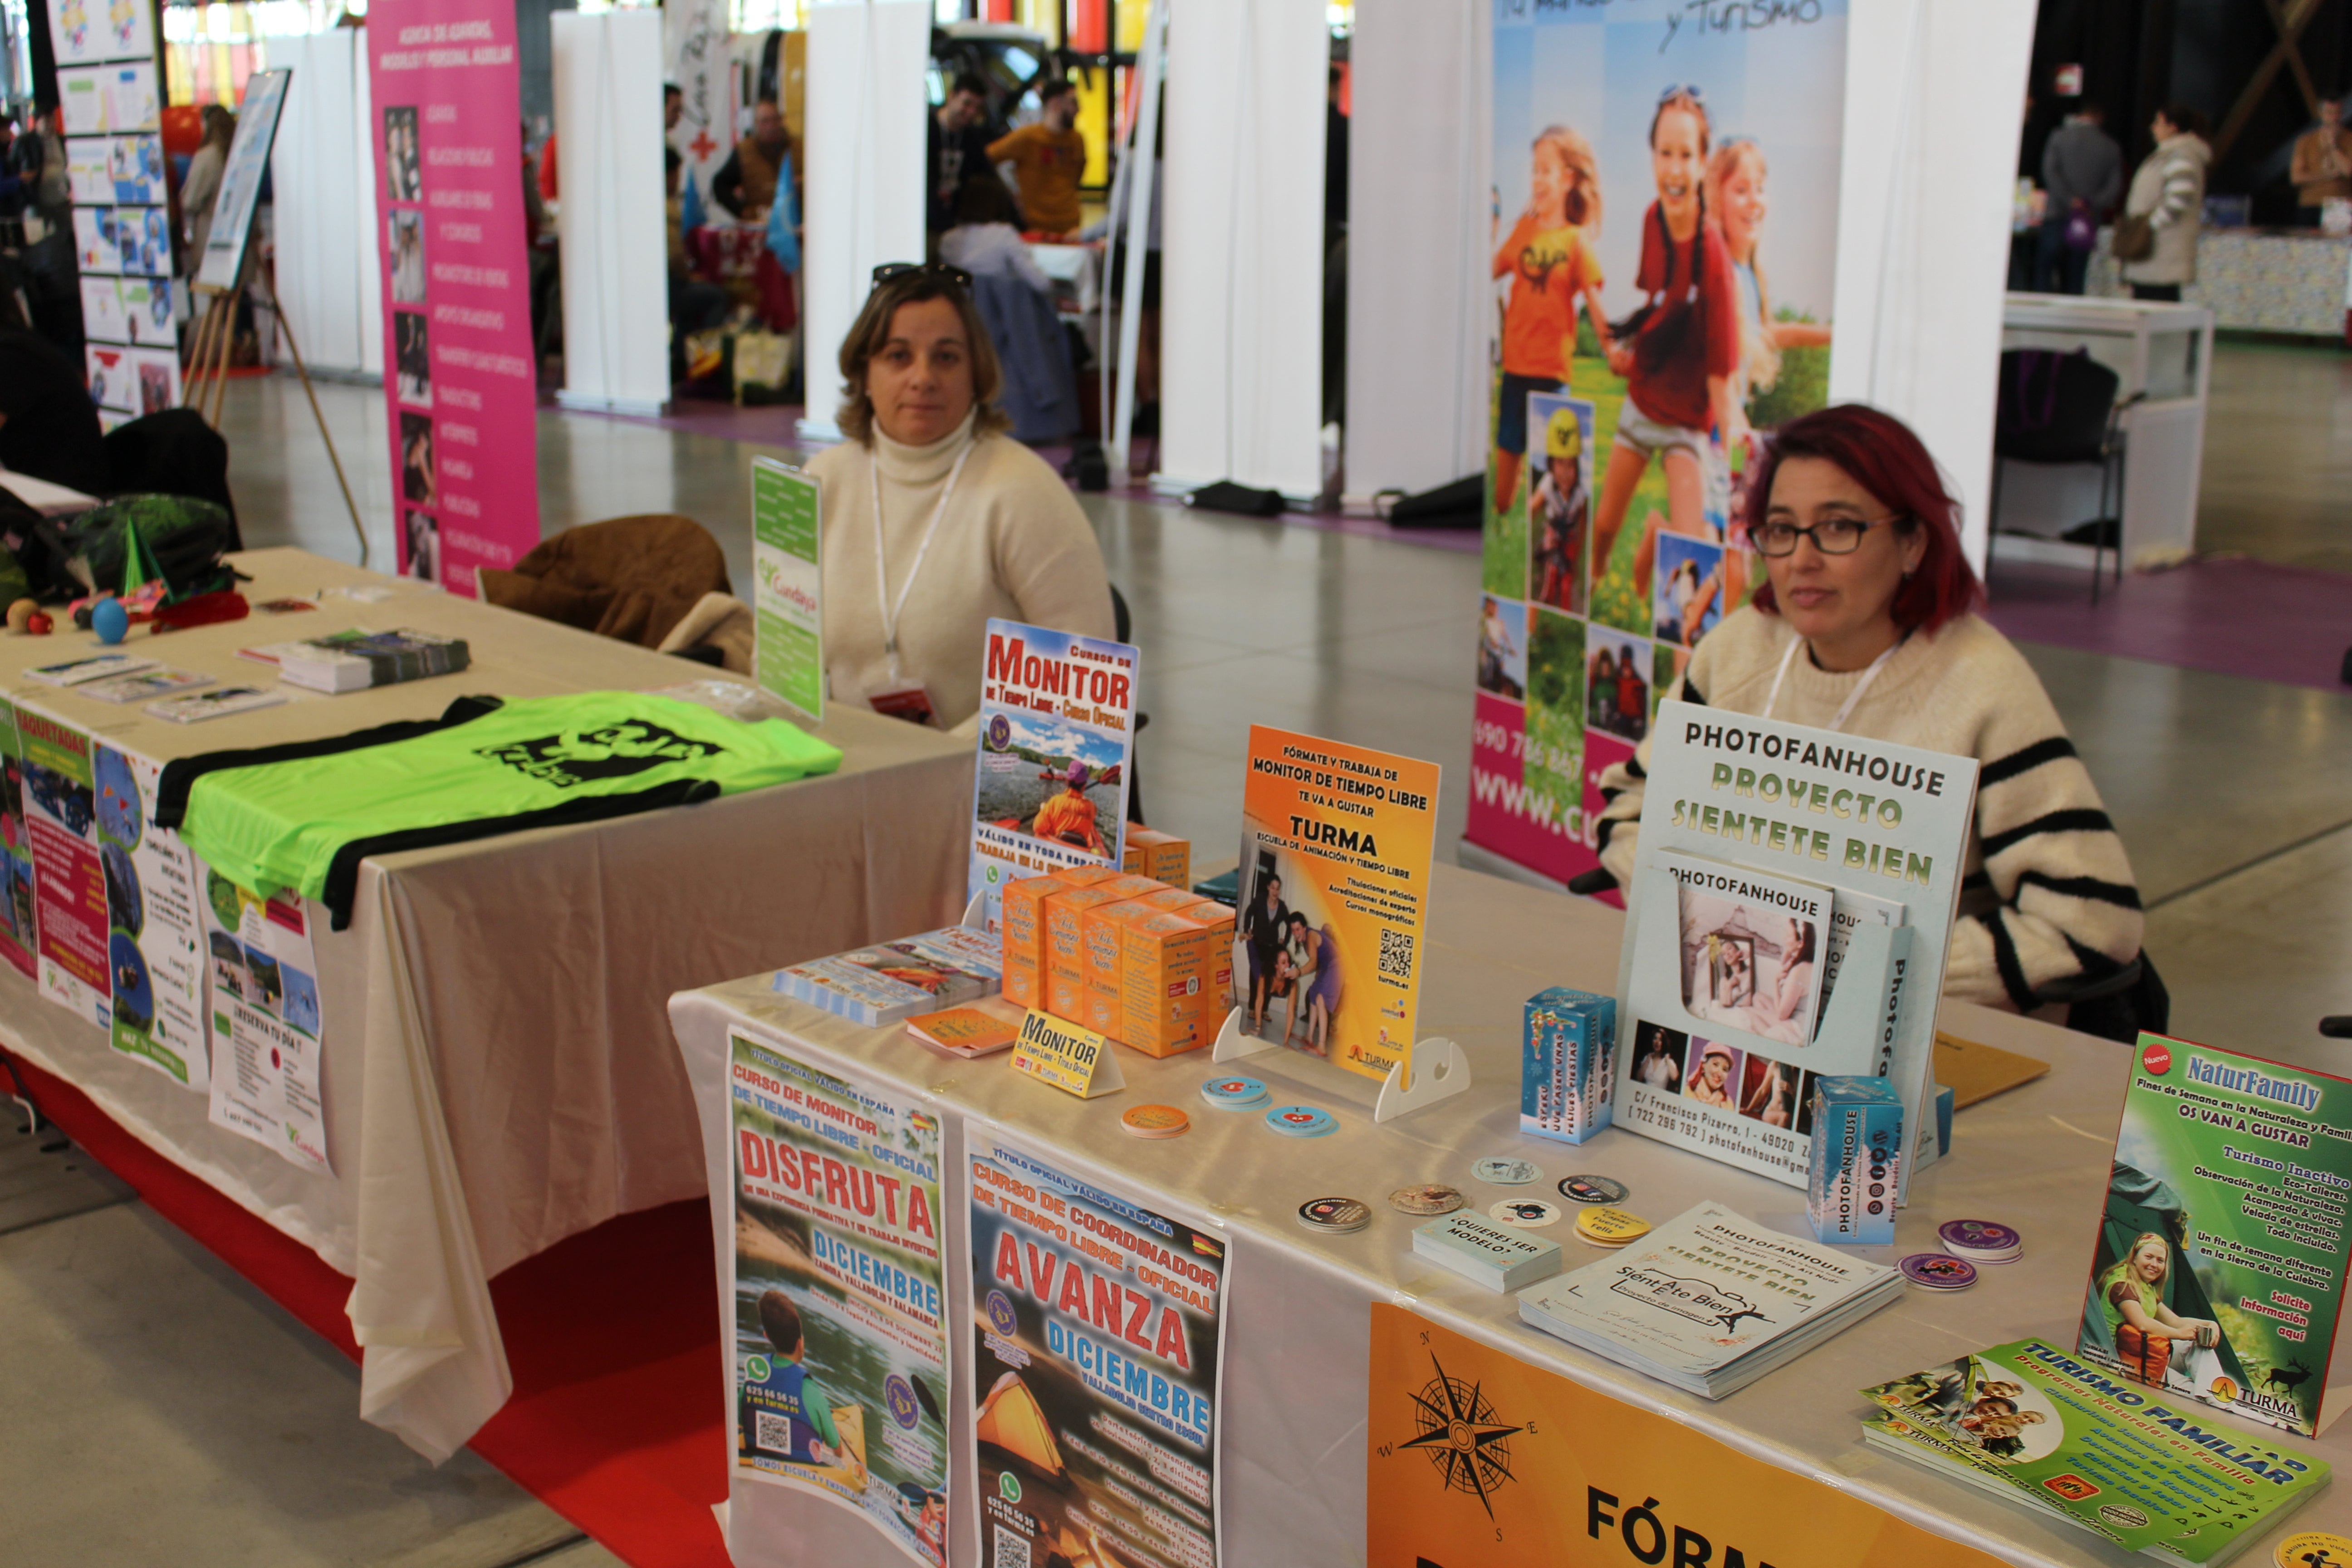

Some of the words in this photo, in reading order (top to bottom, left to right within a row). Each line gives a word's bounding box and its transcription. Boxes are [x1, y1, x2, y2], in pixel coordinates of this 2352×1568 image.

[987, 634, 1129, 710] MONITOR
[1284, 746, 1328, 766] FÓRMATE
[1330, 757, 1336, 767] Y
[1339, 759, 1381, 778] TRABAJA
[1385, 769, 1397, 781] DE
[1686, 722, 1945, 797] PHOTOFANHOUSE
[1253, 758, 1312, 783] MONITOR
[1315, 772, 1332, 787] DE
[1337, 777, 1385, 800] TIEMPO
[1389, 789, 1427, 810] LIBRE
[1299, 790, 1309, 802] TE
[1313, 794, 1324, 805] VA
[1328, 798, 1334, 808] A
[1338, 800, 1374, 817] GUSTAR
[1711, 762, 1903, 830] PROYECTO
[1257, 832, 1287, 847] ESCUELA
[1290, 839, 1299, 850] DE
[1303, 844, 1348, 863] ANIMACIÓN
[1357, 858, 1385, 873] TIEMPO
[1388, 865, 1410, 880] LIBRE
[1290, 815, 1378, 857] TURMA
[1671, 799, 1830, 862] SIENTETE
[1844, 838, 1933, 886] BIEN
[1329, 884, 1377, 904] Acreditaciones
[1390, 899, 1416, 915] experto
[1346, 900, 1367, 913] Cursos
[1369, 907, 1415, 926] monográficos
[1348, 877, 1387, 895] Titulaciones
[1389, 888, 1417, 902] oficiales
[1021, 1014, 1096, 1066] MONITOR
[2144, 1054, 2168, 1065] Nuevo
[733, 1063, 779, 1094] CURSO
[784, 1082, 803, 1105] DE
[806, 1094, 877, 1137] MONITOR
[2136, 1078, 2161, 1092] Fines
[2164, 1085, 2176, 1096] de
[2179, 1088, 2218, 1107] Semana
[2221, 1101, 2233, 1110] en
[2236, 1102, 2246, 1114] la
[2249, 1105, 2308, 1130] Naturaleza
[2187, 1056, 2321, 1111] NaturFamily
[732, 1085, 752, 1103] DE
[756, 1092, 811, 1129] TIEMPO
[813, 1118, 859, 1150] LIBRE
[872, 1146, 937, 1183] OFICIAL
[1634, 1091, 1646, 1104] C/
[1650, 1096, 1697, 1121] Francisco
[1701, 1112, 1741, 1136] Pizarro,
[1761, 1133, 1794, 1153] 49020
[1637, 1108, 1655, 1123] 722
[1657, 1115, 1676, 1130] 296
[1680, 1122, 1698, 1137] 792
[2179, 1104, 2197, 1119] OS
[2201, 1110, 2232, 1128] VAN
[2235, 1119, 2247, 1132] A
[2251, 1122, 2309, 1148] GUSTAR
[740, 1129, 934, 1239] DISFRUTA
[993, 1147, 1028, 1170] TÍTULO
[1030, 1163, 1070, 1189] OFICIAL
[1839, 1110, 1858, 1234] PHOTOFANHOUSE
[2194, 1166, 2254, 1190] Observación
[2256, 1183, 2269, 1195] de
[2271, 1186, 2282, 1197] la
[2284, 1190, 2345, 1215] Naturaleza.
[2223, 1146, 2284, 1171] Turismo
[2288, 1162, 2350, 1189] Inactivo
[2283, 1177, 2347, 1202] Eco-Talleres.
[973, 1162, 1035, 1203] CURSO
[1040, 1192, 1066, 1218] DE
[1070, 1207, 1218, 1292] COORDINADOR
[1591, 1224, 1613, 1234] Feliz
[1593, 1216, 1624, 1229] Fuerte
[2242, 1205, 2278, 1223] Velada
[2279, 1214, 2292, 1227] de
[2295, 1219, 2339, 1240] estrellas.
[2243, 1192, 2298, 1217] Acampada
[2312, 1212, 2342, 1227] vivac.
[2266, 1225, 2291, 1240] Todo
[973, 1184, 995, 1208] DE
[999, 1196, 1067, 1242] TIEMPO
[1071, 1230, 1123, 1271] LIBRE
[1138, 1265, 1215, 1315] OFICIAL
[1446, 1226, 1512, 1256] MODELO?
[1450, 1215, 1513, 1245] ¿QUIERES
[1515, 1237, 1539, 1254] SER
[1694, 1230, 1726, 1246] Beauty
[1814, 1273, 1840, 1284] Nude
[1713, 1225, 1850, 1276] PHOTOFANHOUSE
[2197, 1231, 2211, 1244] Un
[2214, 1235, 2227, 1248] fin
[2230, 1241, 2242, 1252] de
[2244, 1245, 2283, 1263] semana
[2285, 1254, 2332, 1278] diferente
[813, 1229, 938, 1316] DICIEMBRE
[1663, 1245, 1760, 1282] SIENTETE
[1761, 1280, 1817, 1302] BIEN
[1696, 1245, 1809, 1288] PROYECTO
[2200, 1246, 2212, 1256] en
[2215, 1249, 2225, 1260] la
[2227, 1252, 2255, 1269] Sierra
[2258, 1261, 2270, 1273] de
[2273, 1266, 2283, 1276] la
[2285, 1269, 2328, 1291] Culebra.
[996, 1231, 1190, 1370] AVANZA
[1617, 1285, 1657, 1304] Proyecto
[1671, 1307, 1705, 1323] imagen
[1691, 1294, 1733, 1316] Bien
[2271, 1291, 2310, 1312] Solicite
[2278, 1326, 2305, 1342] aquí
[1048, 1319, 1209, 1434] DICIEMBRE
[1082, 1371, 1136, 1410] VALLADOLID
[1137, 1402, 1174, 1431] CENTRO
[1899, 1405, 1936, 1427] TURMA
[2014, 1354, 2092, 1398] Programas
[2092, 1396, 2167, 1440] Naturales
[2170, 1439, 2190, 1451] en
[2191, 1450, 2255, 1485] Familia
[2022, 1343, 2144, 1406] TURISMO
[2141, 1406, 2294, 1485] FAMILIAR
[2239, 1387, 2297, 1418] TURMA
[1908, 1430, 1952, 1451] TURMA
[2043, 1387, 2117, 1427] Cicloturismo
[2117, 1427, 2174, 1459] Sanabria
[2184, 1463, 2235, 1491] Zamora
[2090, 1427, 2148, 1461] Aventura
[2168, 1469, 2220, 1497] Familia
[2065, 1455, 2115, 1485] Turismo
[2116, 1485, 2170, 1515] Inactivo
[2079, 1436, 2141, 1470] Descensos
[2159, 1479, 2204, 1504] Kayak
[2082, 1451, 2139, 1484] Castañas
